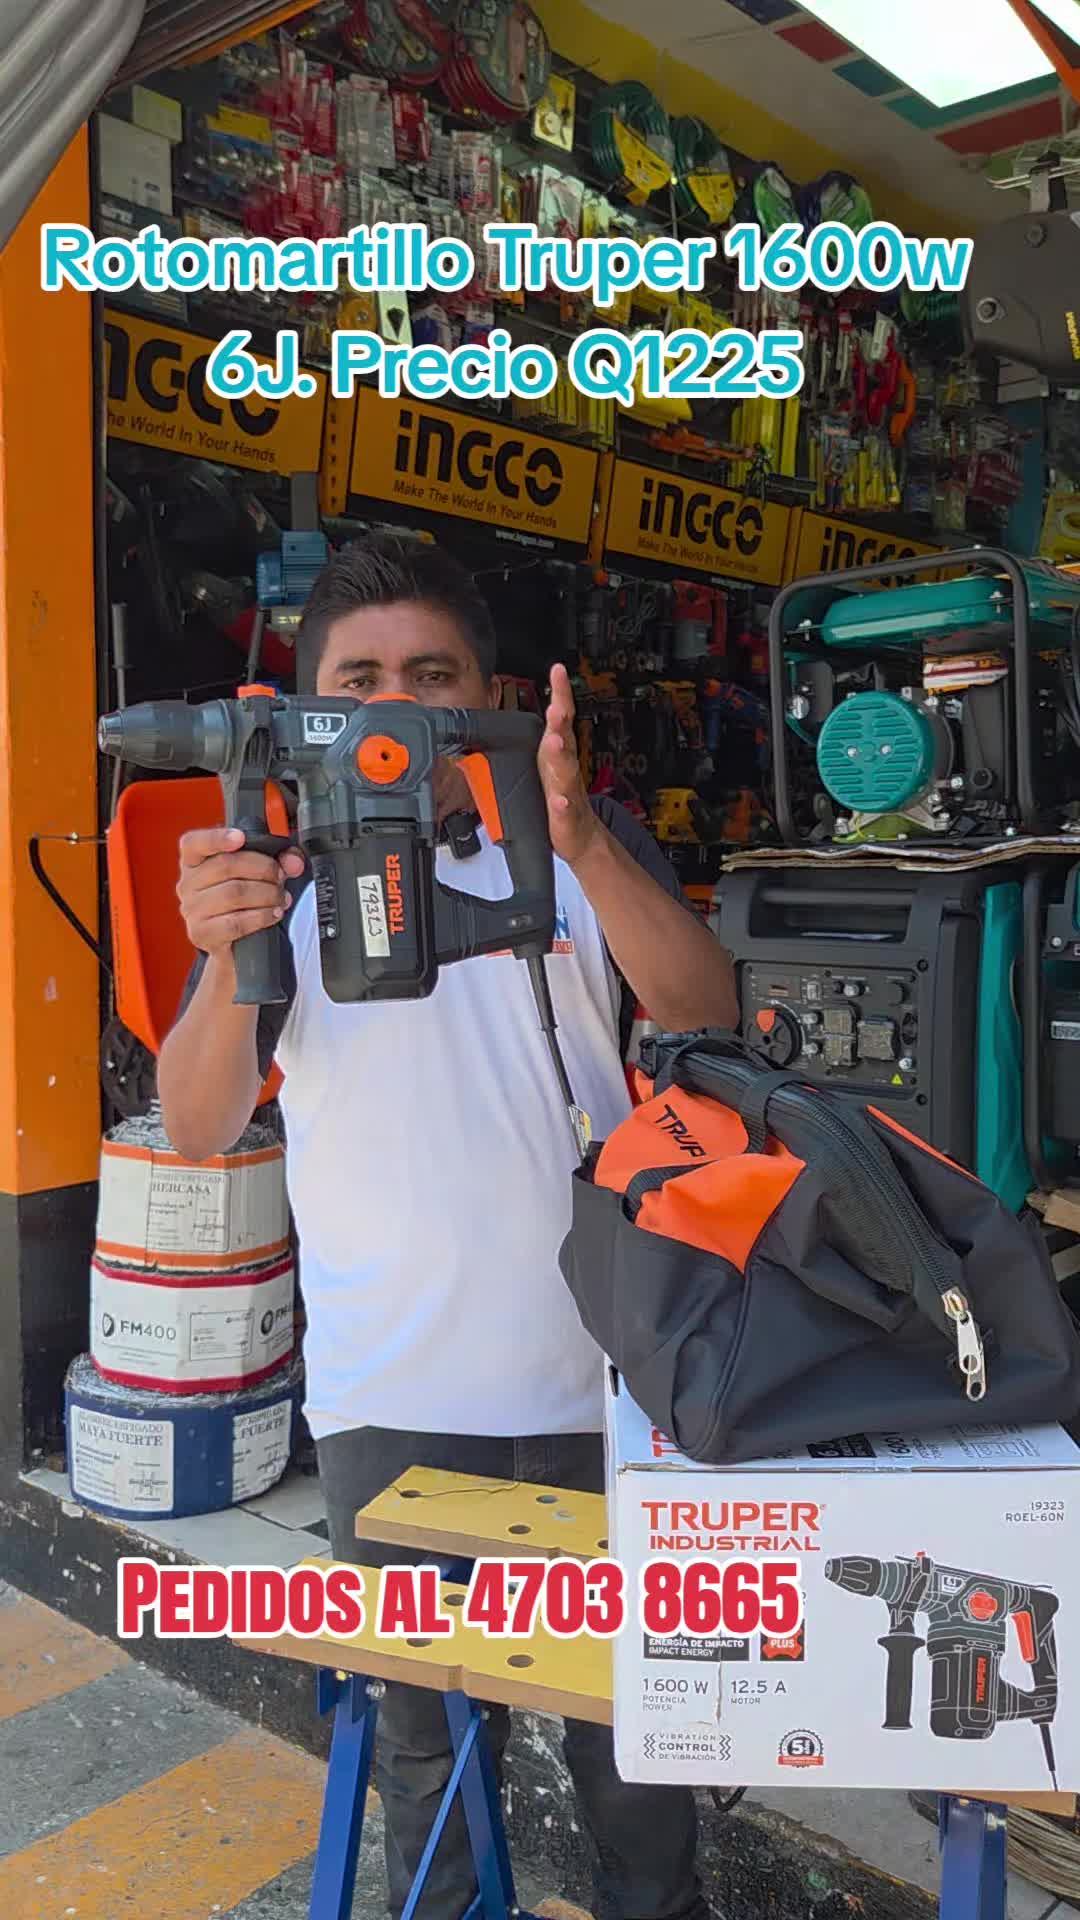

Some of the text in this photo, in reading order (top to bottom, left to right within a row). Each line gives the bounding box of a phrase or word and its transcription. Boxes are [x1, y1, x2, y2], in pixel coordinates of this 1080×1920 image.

[131, 416, 177, 440] World
[179, 426, 193, 442] In
[198, 429, 231, 452] Your
[233, 440, 277, 464] Hands
[394, 480, 425, 499] Make
[429, 487, 449, 504] The
[452, 492, 485, 513] World
[313, 717, 332, 732] 6J
[384, 853, 405, 936] TRUPER
[120, 1319, 177, 1342] FM400
[110, 1430, 164, 1447] FUERTE
[1031, 1501, 1065, 1511] 19323
[1005, 1512, 1065, 1522] ROEL-60N
[650, 1535, 821, 1552] INDUSTRIAL
[690, 1639, 704, 1648] DE
[705, 1638, 745, 1648] IMPACTO
[770, 1639, 795, 1649] PLUS
[649, 1647, 714, 1657] IMPACT ENERGY
[694, 1680, 709, 1695] W
[731, 1680, 787, 1694] 12.5 A
[643, 1695, 687, 1705] POTENCIA
[643, 1703, 672, 1712] POWER
[659, 1743, 717, 1753] CONTROL
[659, 1753, 671, 1761] DE
